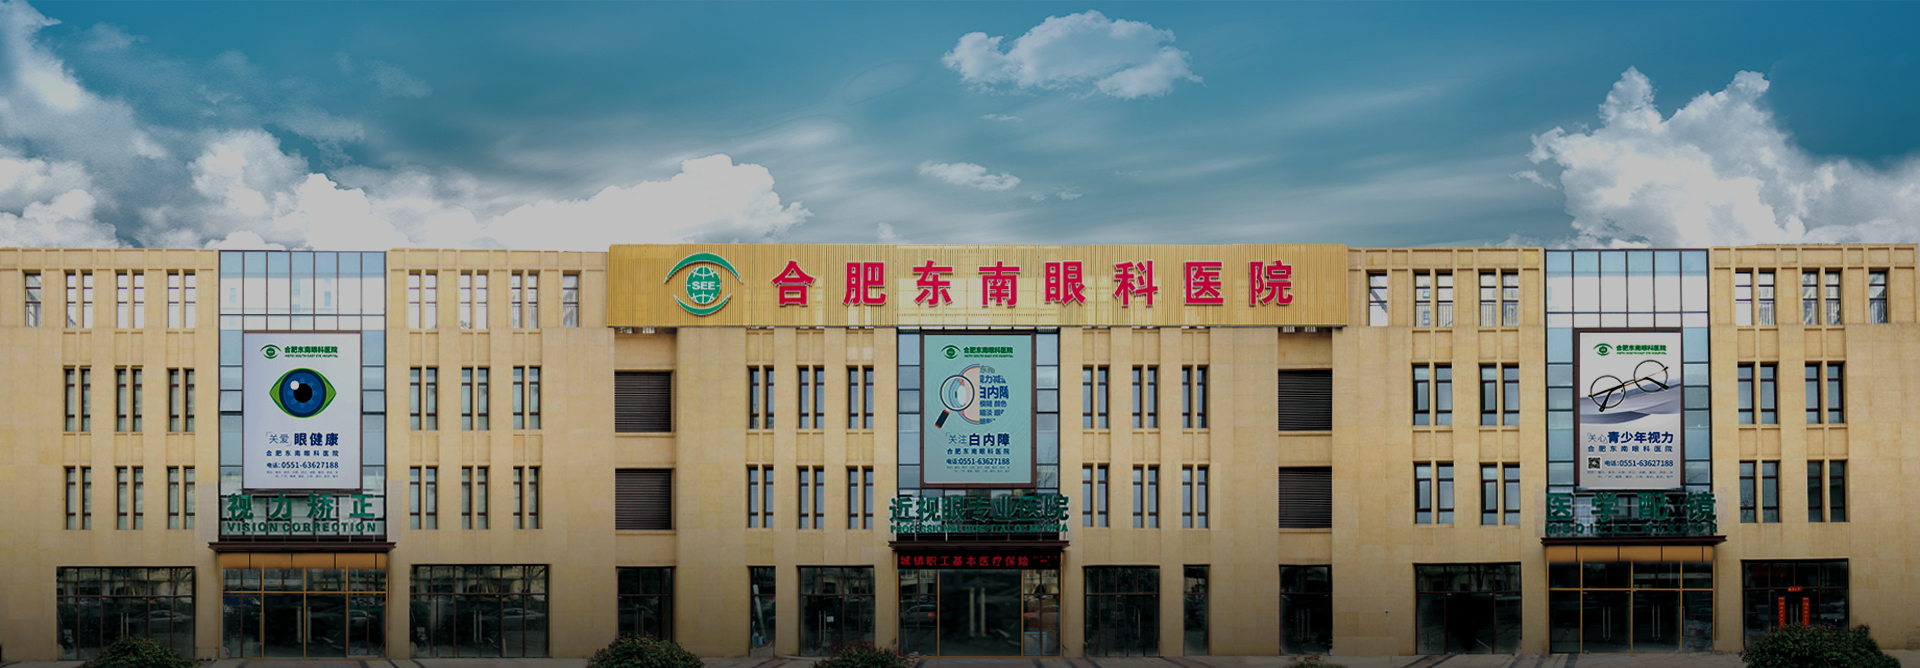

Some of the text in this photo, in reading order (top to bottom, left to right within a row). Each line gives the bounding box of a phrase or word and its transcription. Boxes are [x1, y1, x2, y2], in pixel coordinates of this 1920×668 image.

[691, 280, 716, 290] SEE
[770, 259, 1294, 307] 合肥东南眼科医院
[294, 432, 339, 447] 眼健康
[969, 432, 1011, 447] 白内障
[1607, 431, 1674, 444] 青少年视力
[1587, 445, 1673, 453] 合肥东南眼科医院
[227, 493, 375, 520] 视力矫正
[889, 494, 1070, 522] 近视眼专业医院
[1546, 491, 1717, 521] 医学配镜
[227, 522, 376, 533] VISION CORRECTION
[890, 524, 962, 533] PROFESSIONAL
[964, 524, 1013, 533] HOSPITAL
[1029, 523, 1069, 533] MYOPIA
[1545, 522, 1633, 535] MEDICAL
[900, 555, 1029, 567] 城镇职工基本医疗保险
